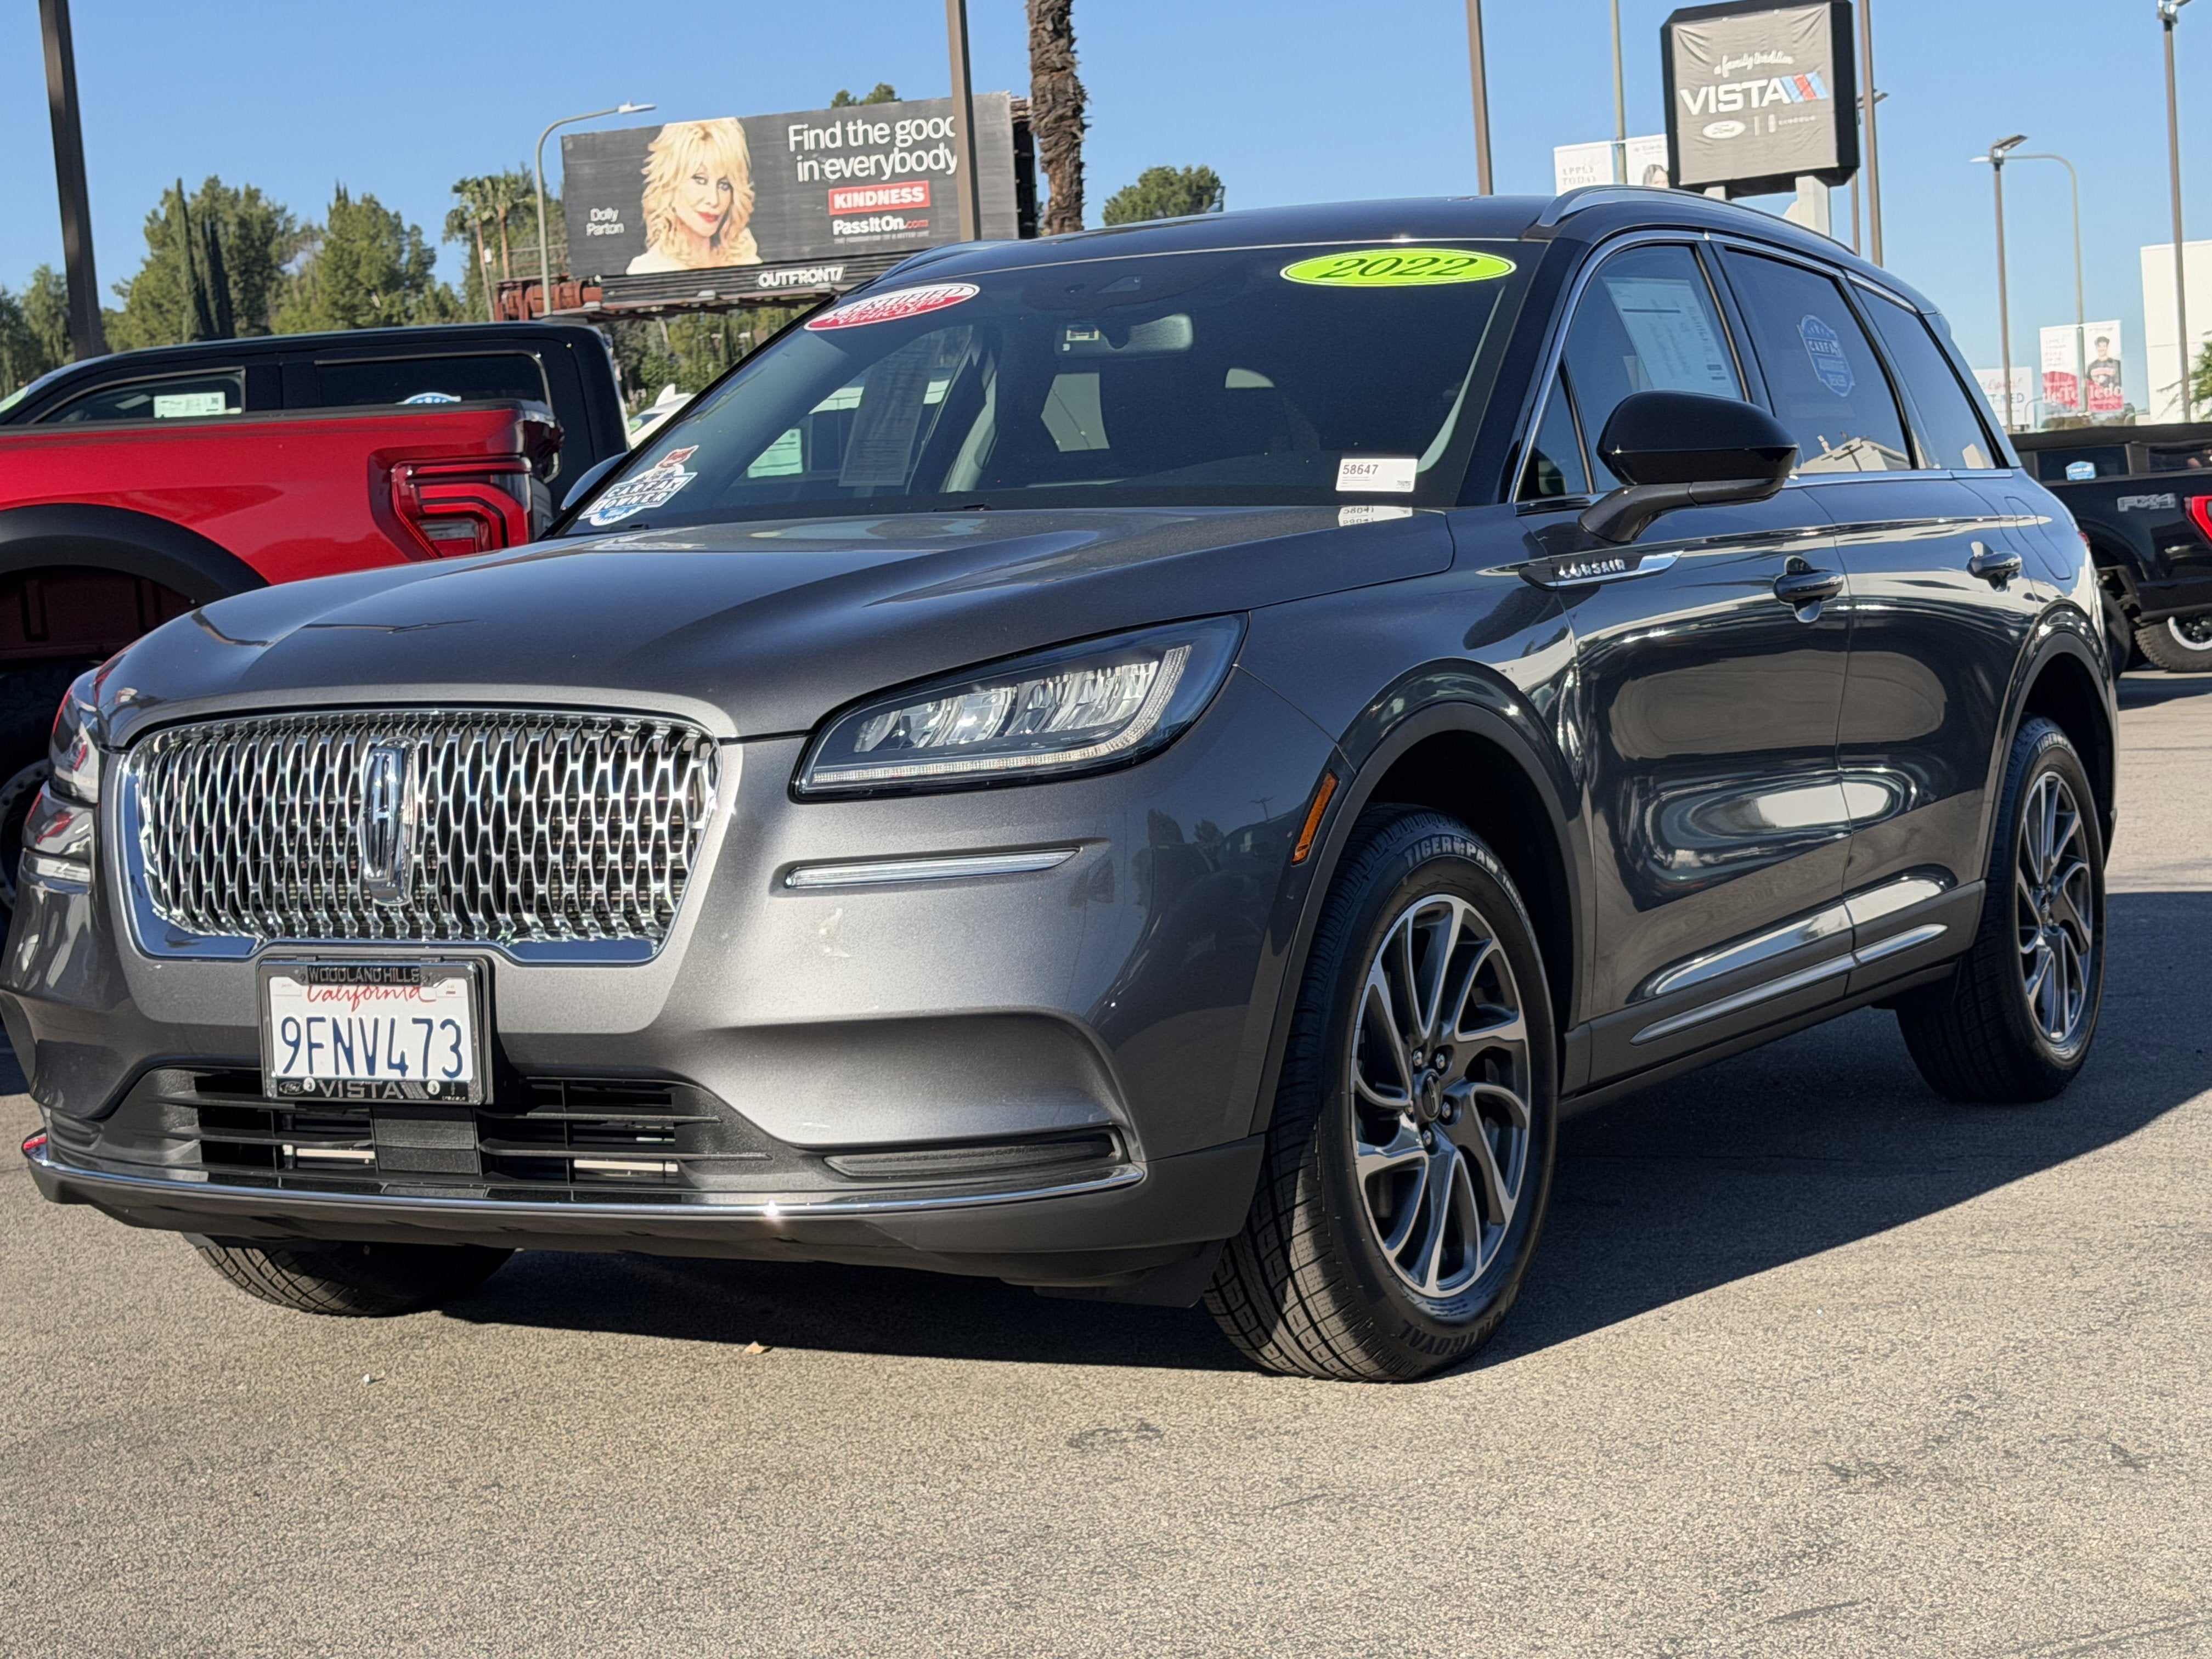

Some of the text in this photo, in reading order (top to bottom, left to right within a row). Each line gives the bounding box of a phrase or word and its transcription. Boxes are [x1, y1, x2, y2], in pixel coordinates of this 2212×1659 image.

[1679, 77, 1792, 116] VISTA
[788, 120, 843, 152] Find
[845, 119, 890, 146] the
[796, 142, 957, 182] in everybody
[833, 186, 926, 210] KINDNESS
[590, 207, 619, 222] Dolly
[832, 215, 929, 235] PassItOn.com
[586, 222, 625, 236] Parton
[1314, 257, 1479, 279] 2022
[833, 287, 965, 317] CERTIFIED
[1342, 464, 1379, 475] 58647
[606, 476, 687, 498] CARFAX
[604, 492, 668, 509] OWNER
[2117, 493, 2176, 512] FX4
[1404, 836, 1498, 873] TIGER PAW
[308, 967, 421, 984] WOODLAND HILLS
[307, 985, 437, 1013] California
[280, 1016, 464, 1079] 9FNV473
[317, 1079, 404, 1099] VISTA
